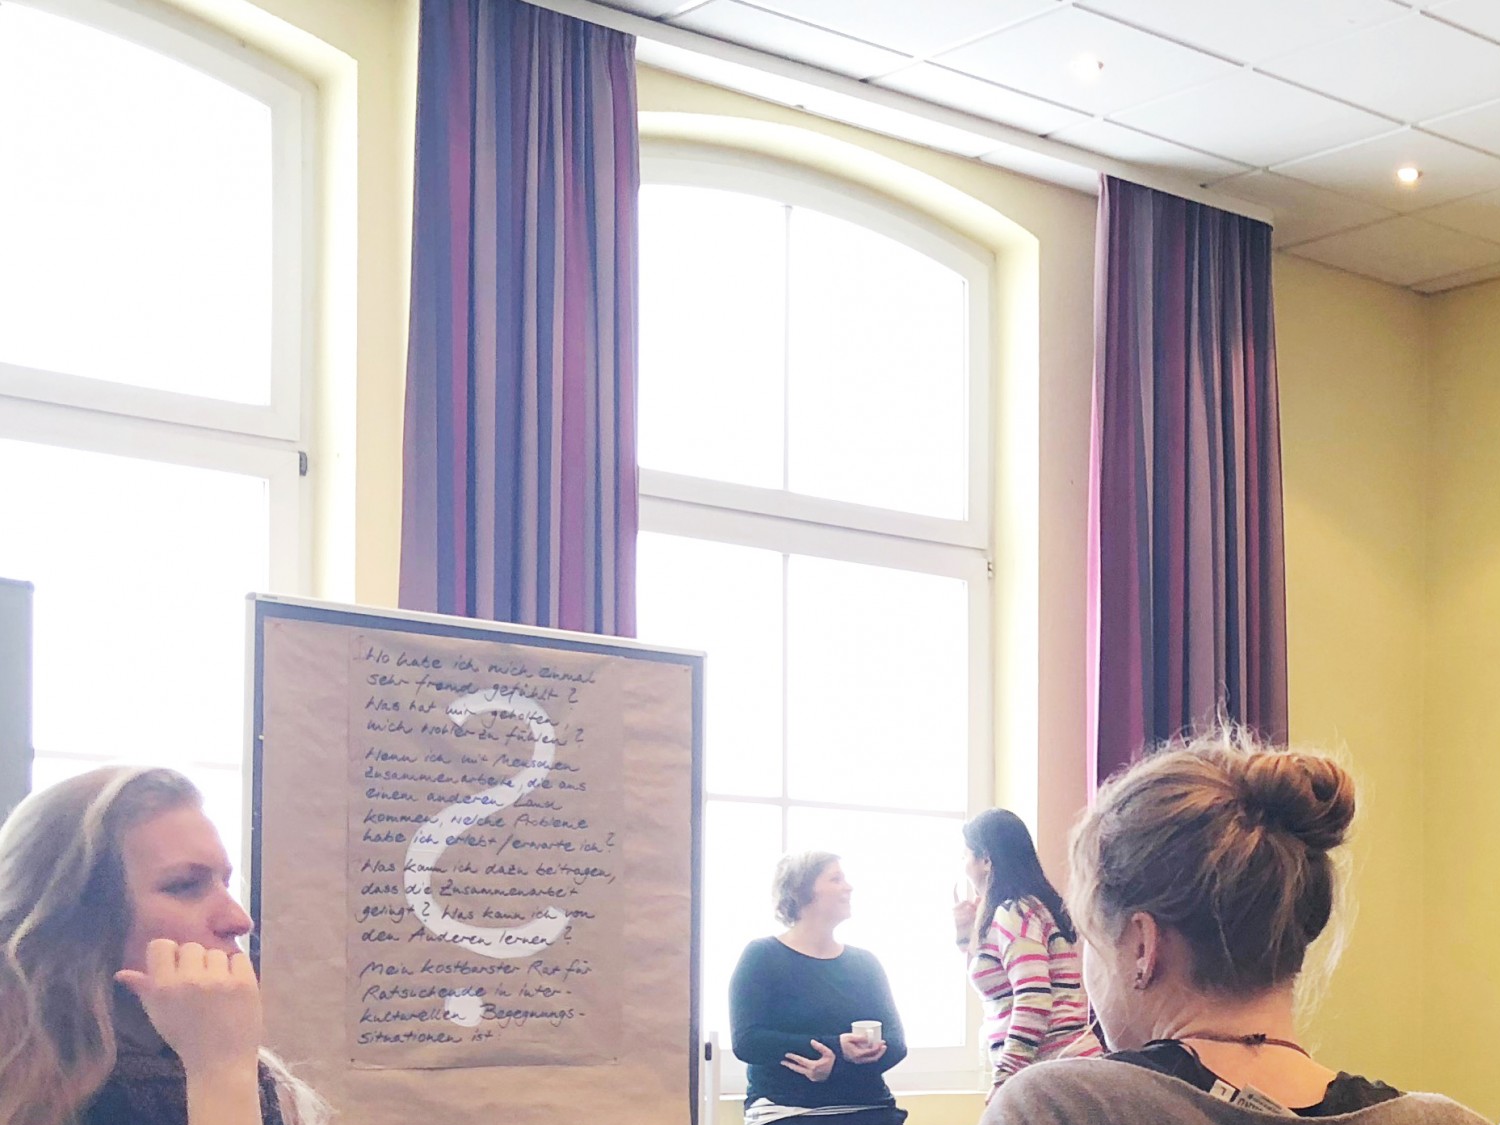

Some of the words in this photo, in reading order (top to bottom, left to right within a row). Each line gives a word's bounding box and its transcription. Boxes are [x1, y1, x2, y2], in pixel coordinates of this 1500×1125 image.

[396, 651, 442, 669] habe
[453, 654, 480, 672] ich
[488, 660, 534, 678] mich
[538, 666, 596, 684] einmal
[366, 673, 409, 686] sehr
[415, 674, 479, 695] fremd
[365, 696, 400, 711] Was
[409, 700, 436, 713] hat
[445, 703, 476, 716] mir
[366, 719, 413, 734] mich
[478, 729, 499, 741] zu
[365, 747, 417, 764] Wenn
[424, 750, 451, 764] ich
[461, 754, 488, 764] mit
[492, 754, 580, 772] Menschen
[527, 778, 553, 789] die
[558, 781, 587, 792] aus
[426, 792, 504, 807] anderen
[514, 793, 563, 811] Land
[363, 808, 444, 828] kommen,
[451, 814, 505, 828] welche
[514, 813, 588, 830] Probleme
[362, 828, 406, 843] habe
[413, 830, 440, 845] ich
[361, 858, 396, 874] Was
[403, 858, 448, 874] kann
[453, 860, 478, 874] ich
[485, 862, 528, 876] dazu
[536, 862, 616, 885] beitragen,
[360, 882, 399, 895] dass
[405, 883, 433, 896] die
[439, 879, 578, 898] Zusammenarbeit
[354, 904, 415, 924] gelingt
[442, 904, 474, 920] Was
[482, 904, 525, 920] kann
[532, 906, 557, 920] ich
[564, 910, 596, 920] von
[361, 928, 400, 942] den
[498, 930, 554, 946] lernen
[359, 960, 414, 978] Mein
[420, 958, 520, 975] kostbarster
[527, 960, 560, 976] Rat
[562, 958, 592, 982] für
[362, 984, 487, 1003] Ratsuchende
[495, 982, 512, 997] in
[359, 1008, 466, 1024] kulturellen
